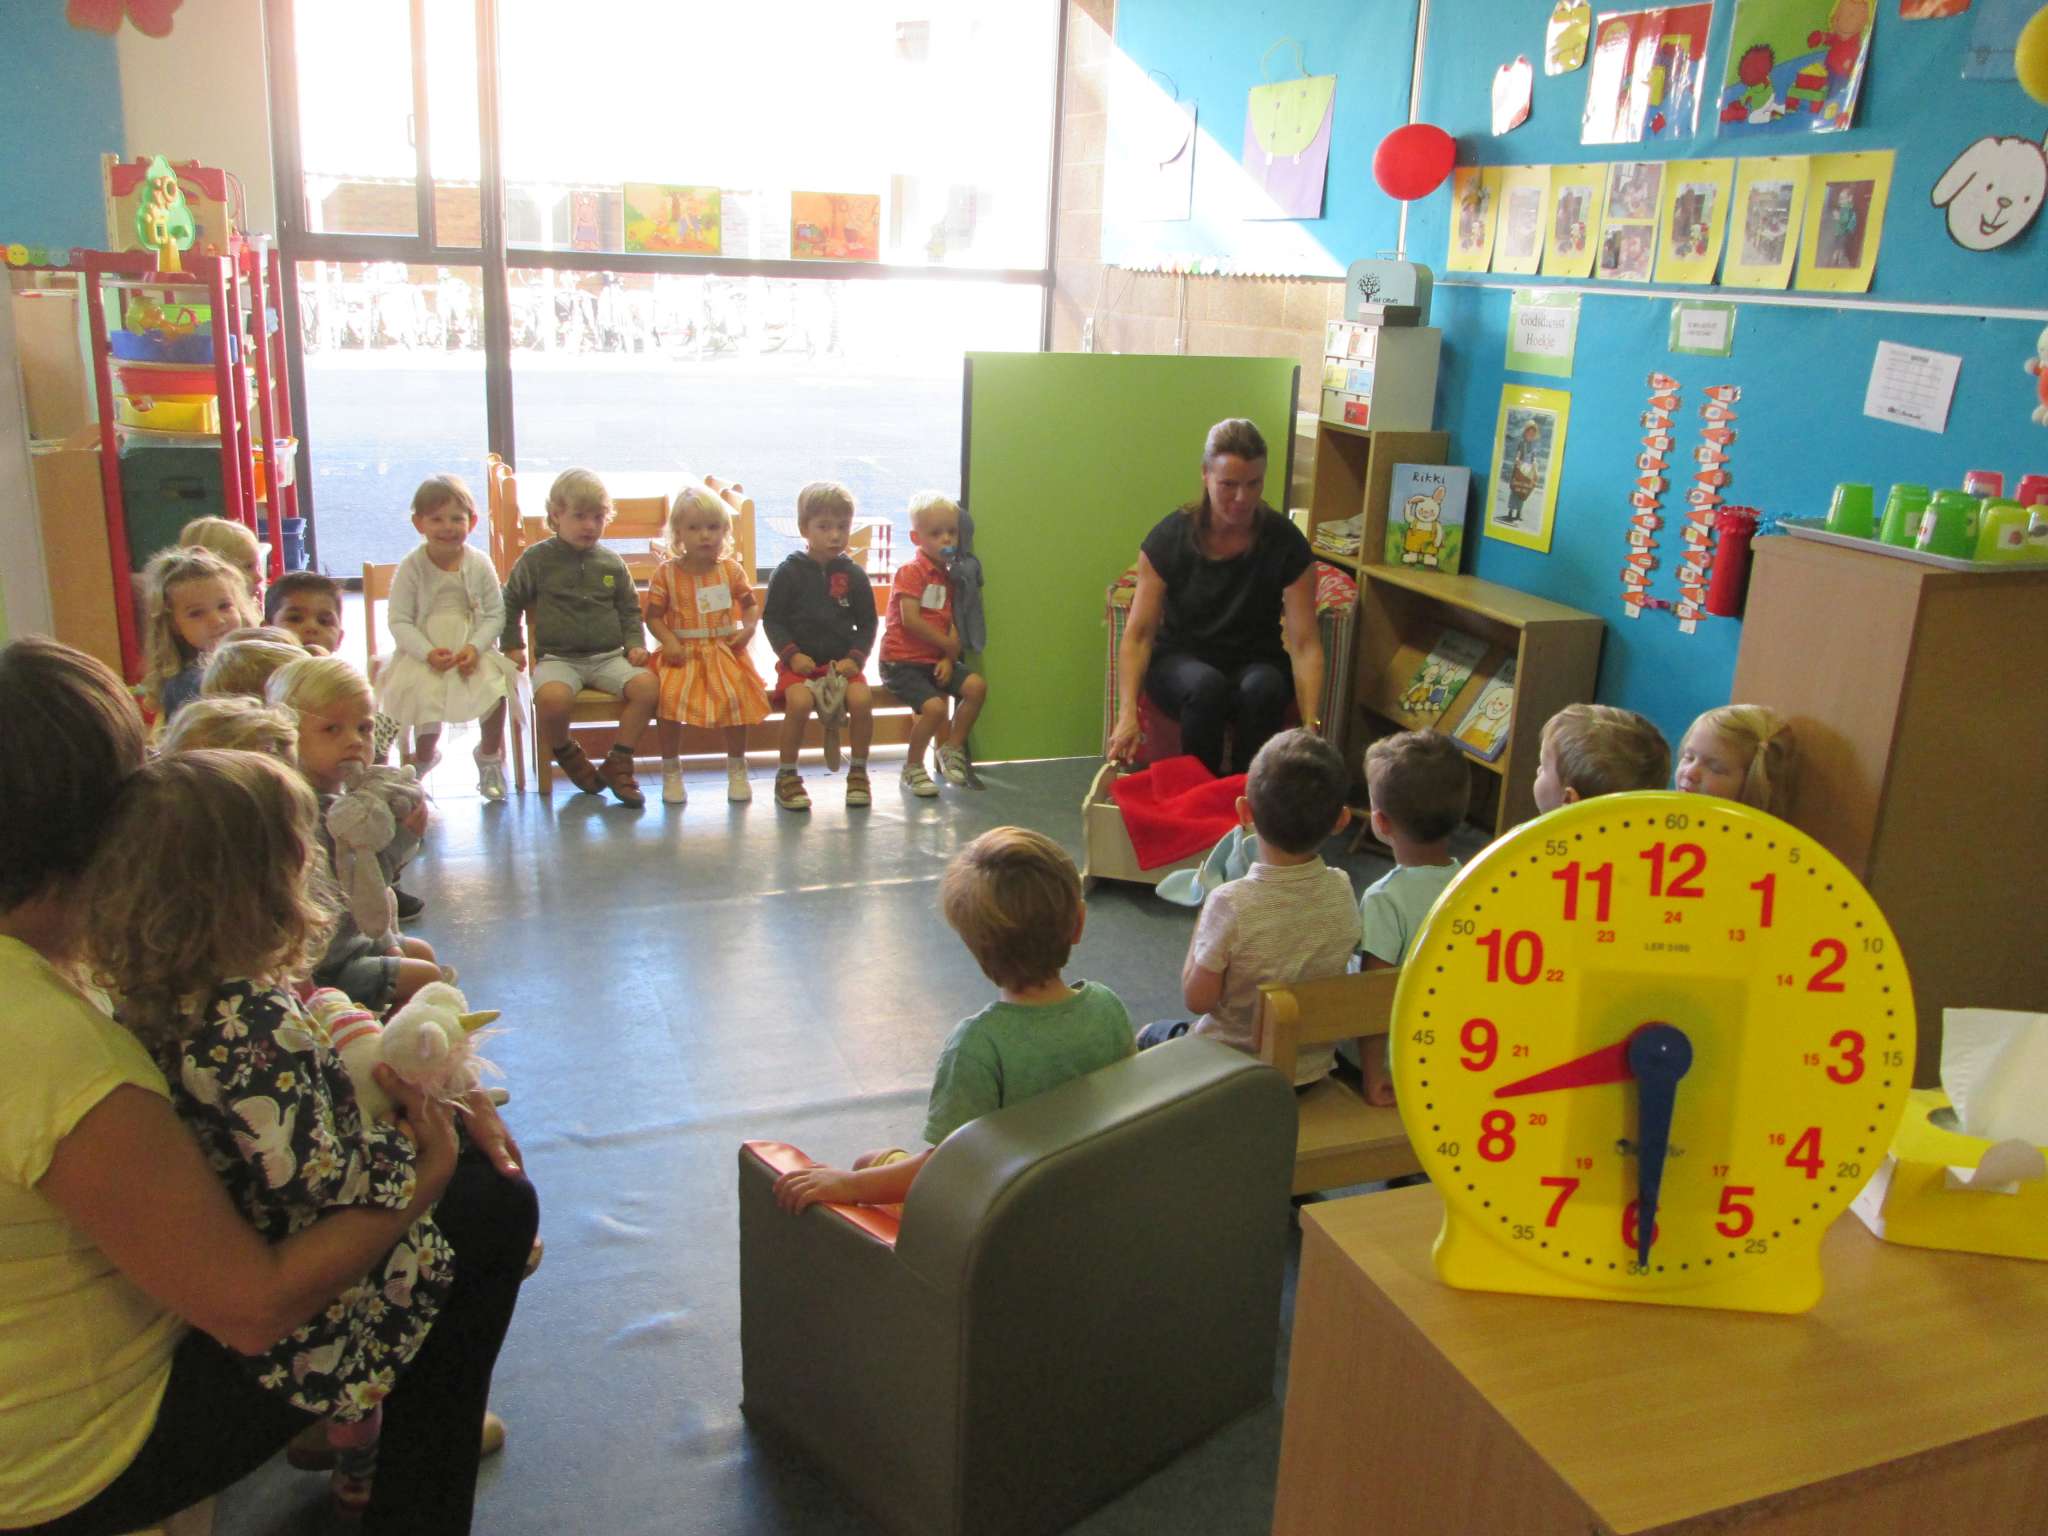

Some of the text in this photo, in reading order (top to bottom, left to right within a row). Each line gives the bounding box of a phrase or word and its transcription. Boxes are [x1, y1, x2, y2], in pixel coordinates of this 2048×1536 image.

[1665, 813, 1688, 830] 60
[1545, 839, 1568, 857] 55
[1789, 848, 1801, 864] 5
[1639, 841, 1707, 899] 12
[1551, 860, 1614, 923] 11
[1749, 872, 1777, 929] 1
[1664, 911, 1683, 925] 24
[1452, 919, 1476, 936] 50
[1727, 928, 1746, 943] 13
[1596, 930, 1616, 944] 23
[1863, 937, 1884, 954] 10
[1475, 928, 1544, 986] 10
[1806, 938, 1848, 993] 2
[1546, 968, 1565, 983] 22
[1775, 974, 1794, 988] 14
[1412, 1029, 1435, 1046] 45
[1459, 1018, 1499, 1072] 9
[1512, 1044, 1530, 1058] 21
[1825, 1029, 1866, 1085] 3
[1883, 1050, 1903, 1067] 15
[1802, 1053, 1820, 1067] 15
[1528, 1113, 1548, 1126] 20
[1476, 1109, 1517, 1163] 8
[1768, 1132, 1786, 1146] 16
[1436, 1141, 1460, 1157] 40
[1785, 1126, 1825, 1180] 4
[1575, 1156, 1594, 1170] 19
[1711, 1164, 1730, 1178] 17
[1836, 1162, 1861, 1179] 20
[1539, 1176, 1580, 1228] 7
[1715, 1185, 1756, 1239] 5
[1512, 1224, 1535, 1241] 35
[1744, 1238, 1768, 1255] 25
